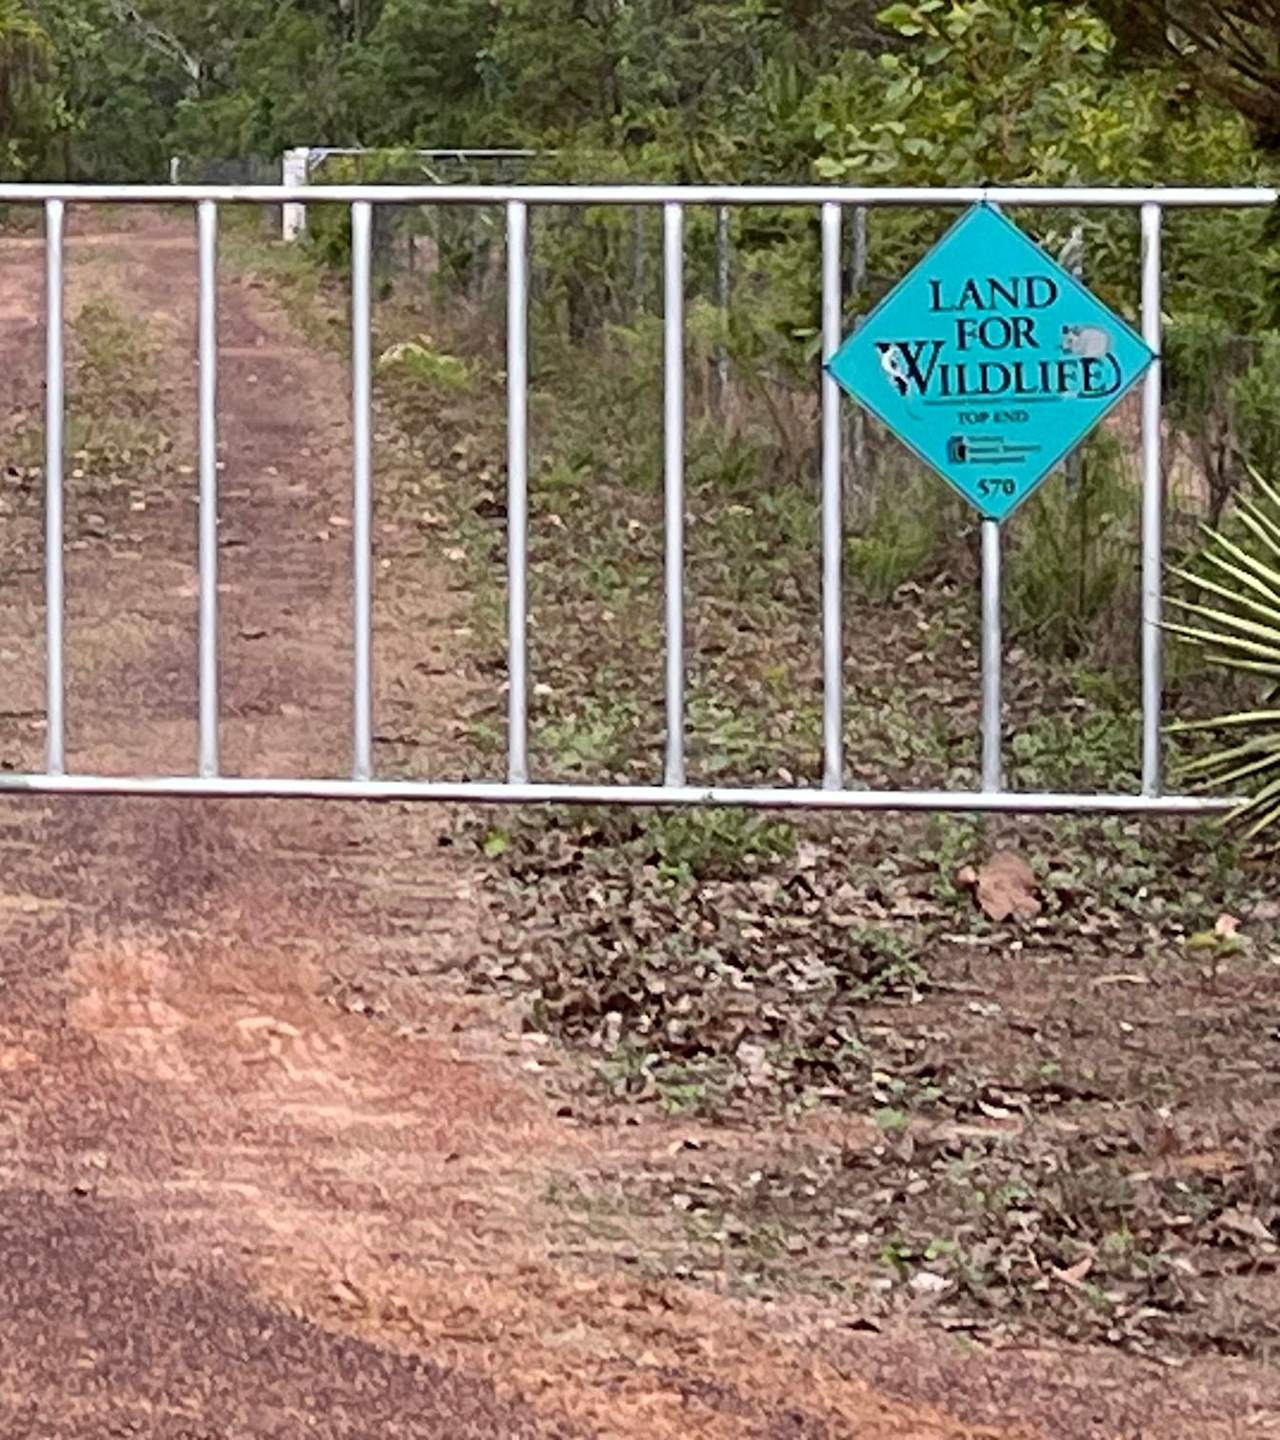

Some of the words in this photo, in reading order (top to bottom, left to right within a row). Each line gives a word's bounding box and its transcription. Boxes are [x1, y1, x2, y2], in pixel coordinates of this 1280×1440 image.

[928, 276, 1057, 312] LAND
[955, 316, 1040, 351] FOR
[873, 340, 1109, 397] WILDLIFE
[957, 410, 990, 425] TOP
[993, 409, 1030, 424] END
[977, 478, 1016, 497] 570
